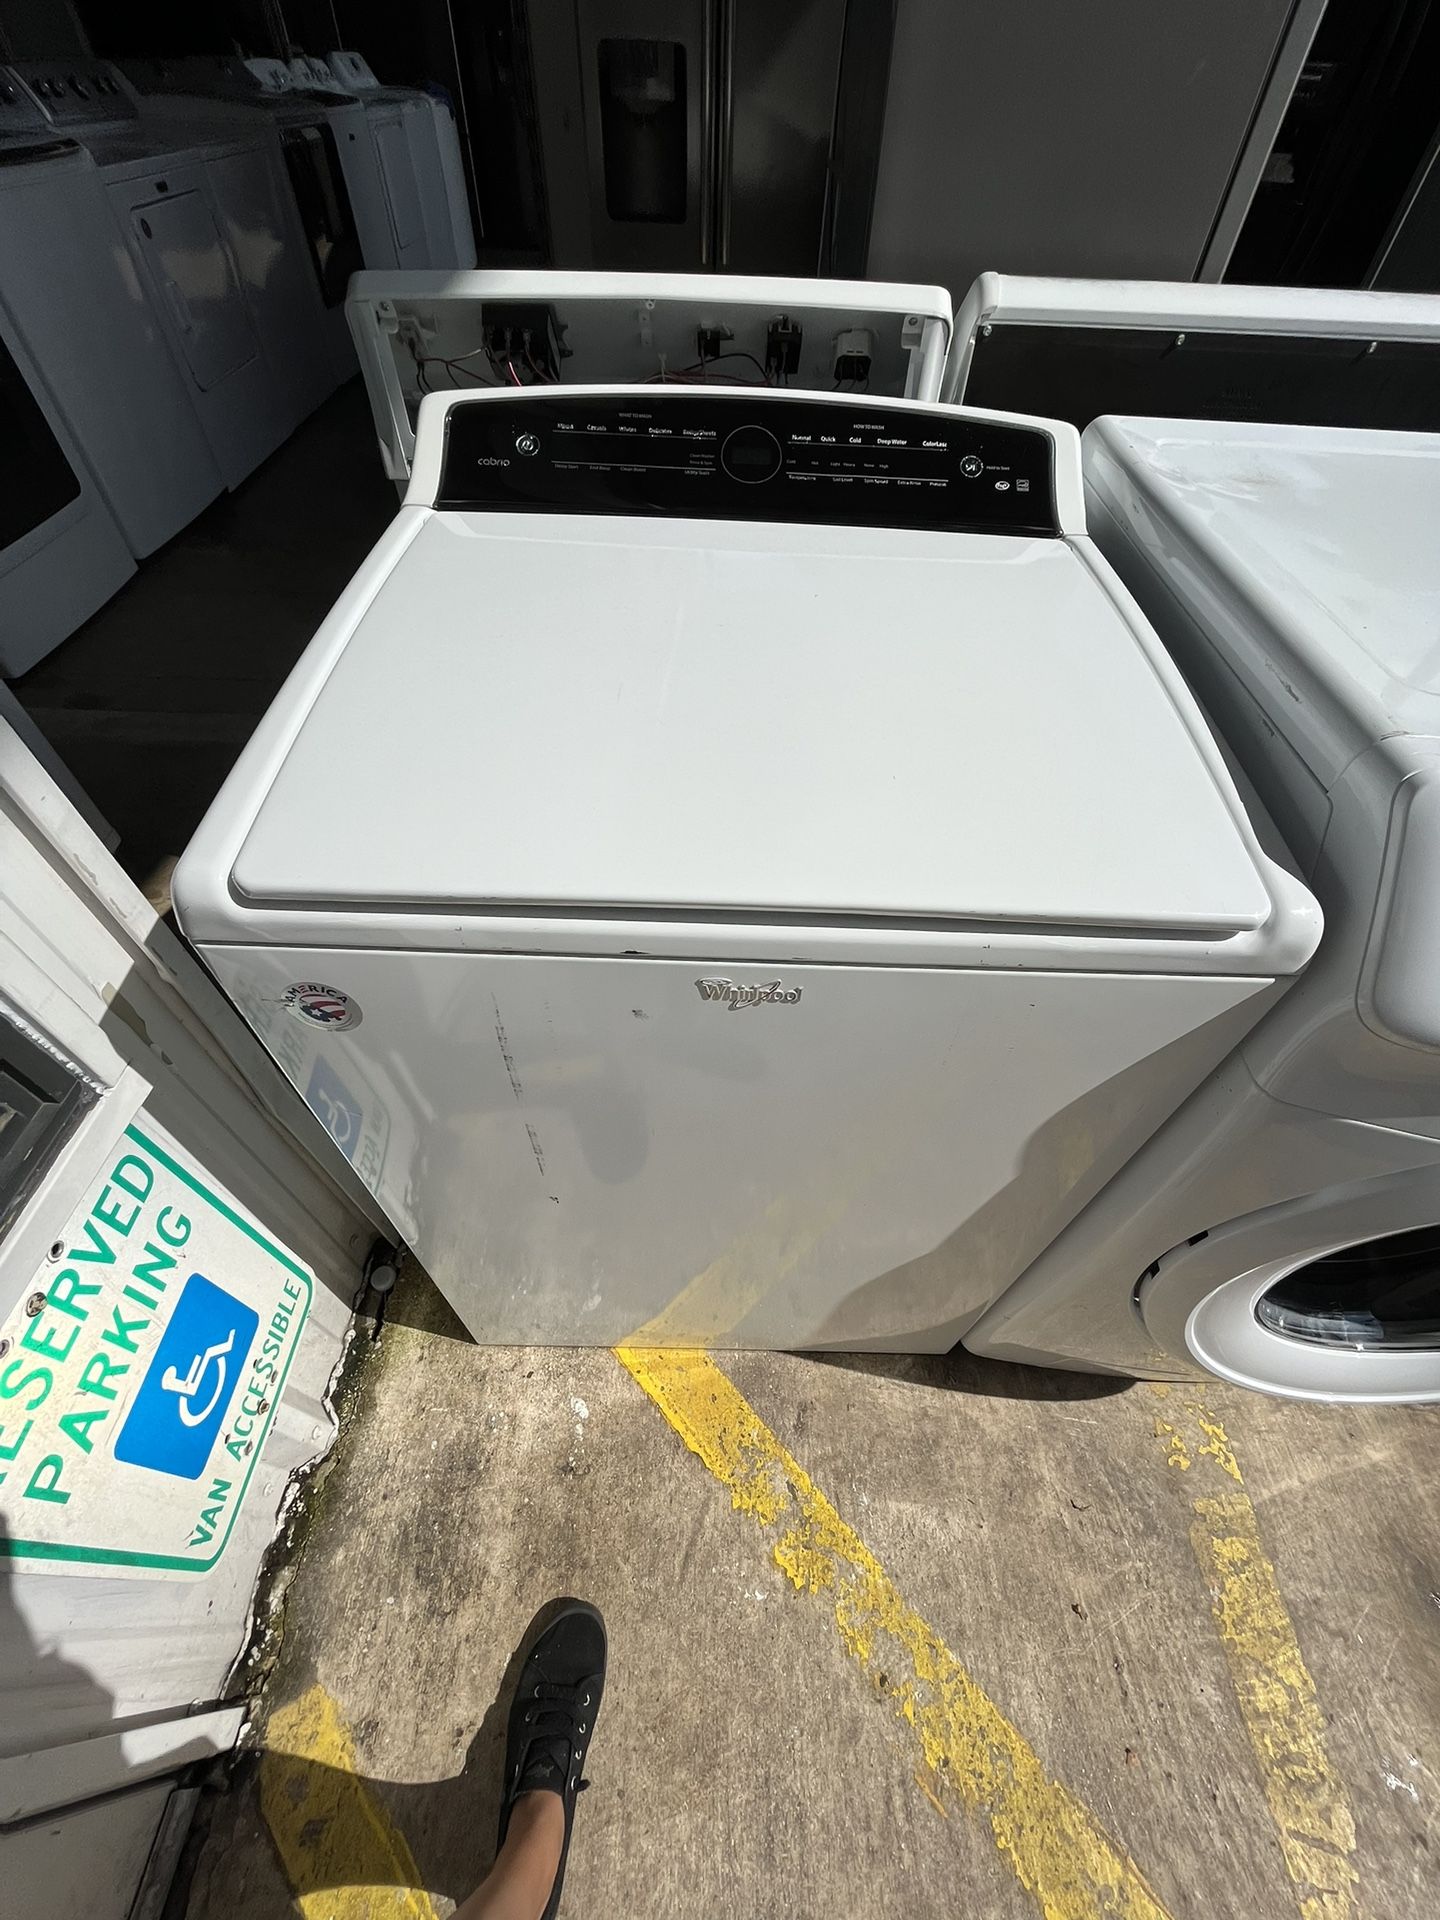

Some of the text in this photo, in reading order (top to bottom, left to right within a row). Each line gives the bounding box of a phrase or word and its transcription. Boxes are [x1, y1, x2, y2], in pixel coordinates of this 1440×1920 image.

[477, 457, 511, 467] cabrio
[695, 977, 804, 1011] Whirlpool
[22, 1205, 192, 1505] PARKING
[188, 1278, 302, 1547] VAN ACCESSIBLE
